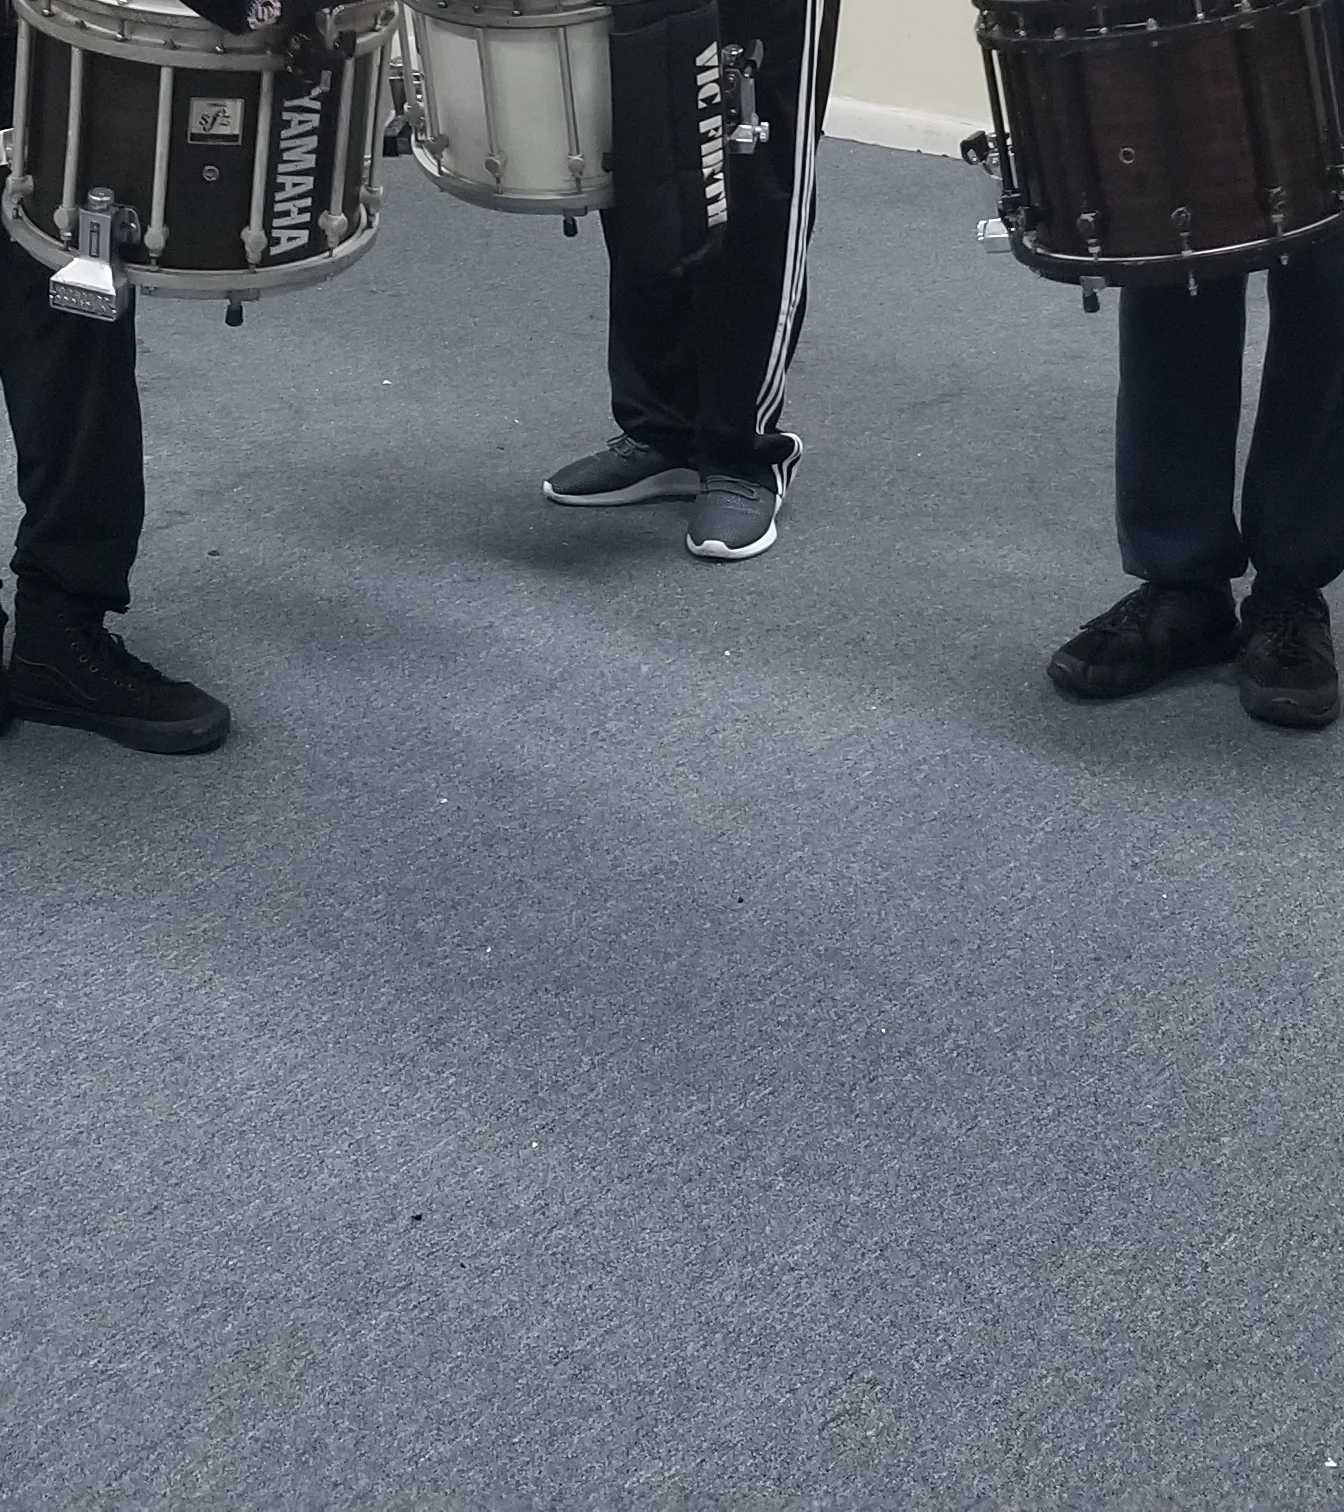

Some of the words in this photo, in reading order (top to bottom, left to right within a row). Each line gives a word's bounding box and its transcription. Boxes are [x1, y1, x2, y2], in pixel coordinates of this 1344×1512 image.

[695, 40, 722, 110] VIC
[269, 85, 324, 257] YAMAHA
[699, 115, 728, 228] FIRTH
